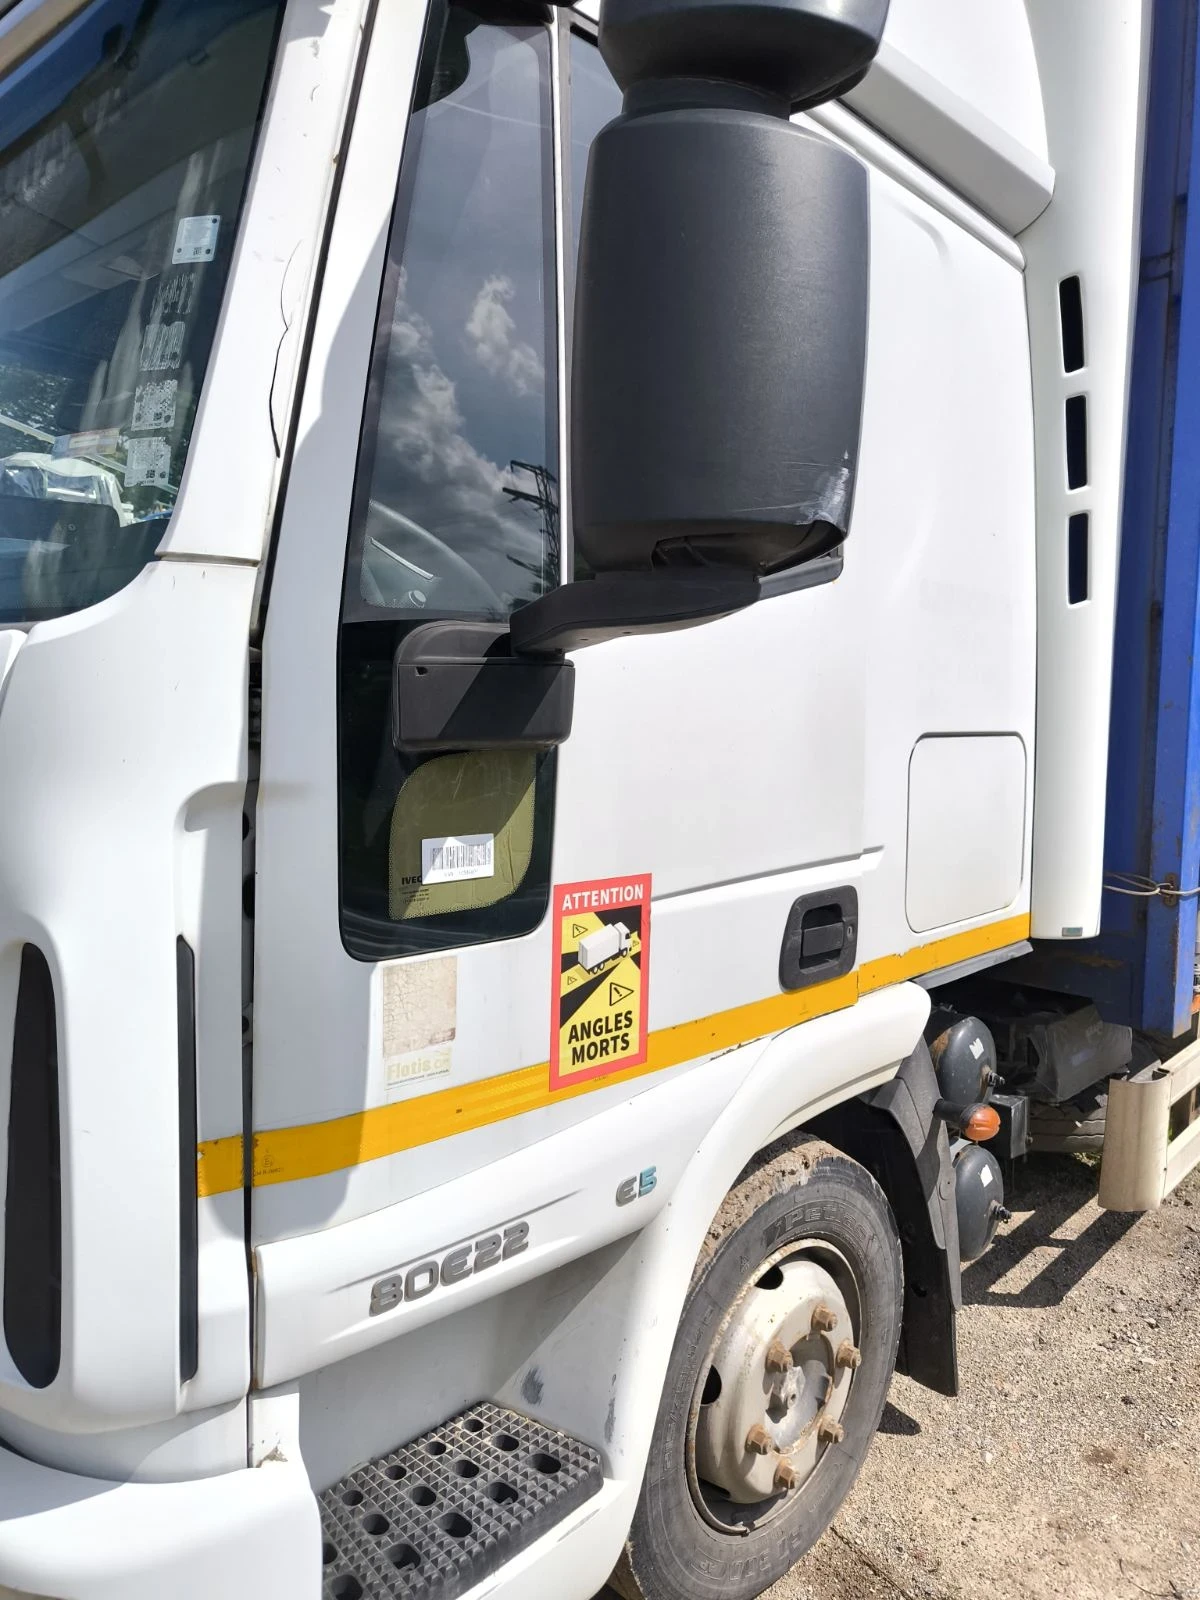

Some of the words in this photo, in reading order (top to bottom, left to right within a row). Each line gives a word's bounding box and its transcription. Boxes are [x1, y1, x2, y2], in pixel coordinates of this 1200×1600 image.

[402, 875, 422, 886] IVEC
[562, 884, 644, 911] ATTENTION
[568, 1010, 634, 1044] ANGLES
[571, 1032, 630, 1066] MORTS
[615, 1165, 658, 1207] E5
[369, 1221, 530, 1317] 80E22
